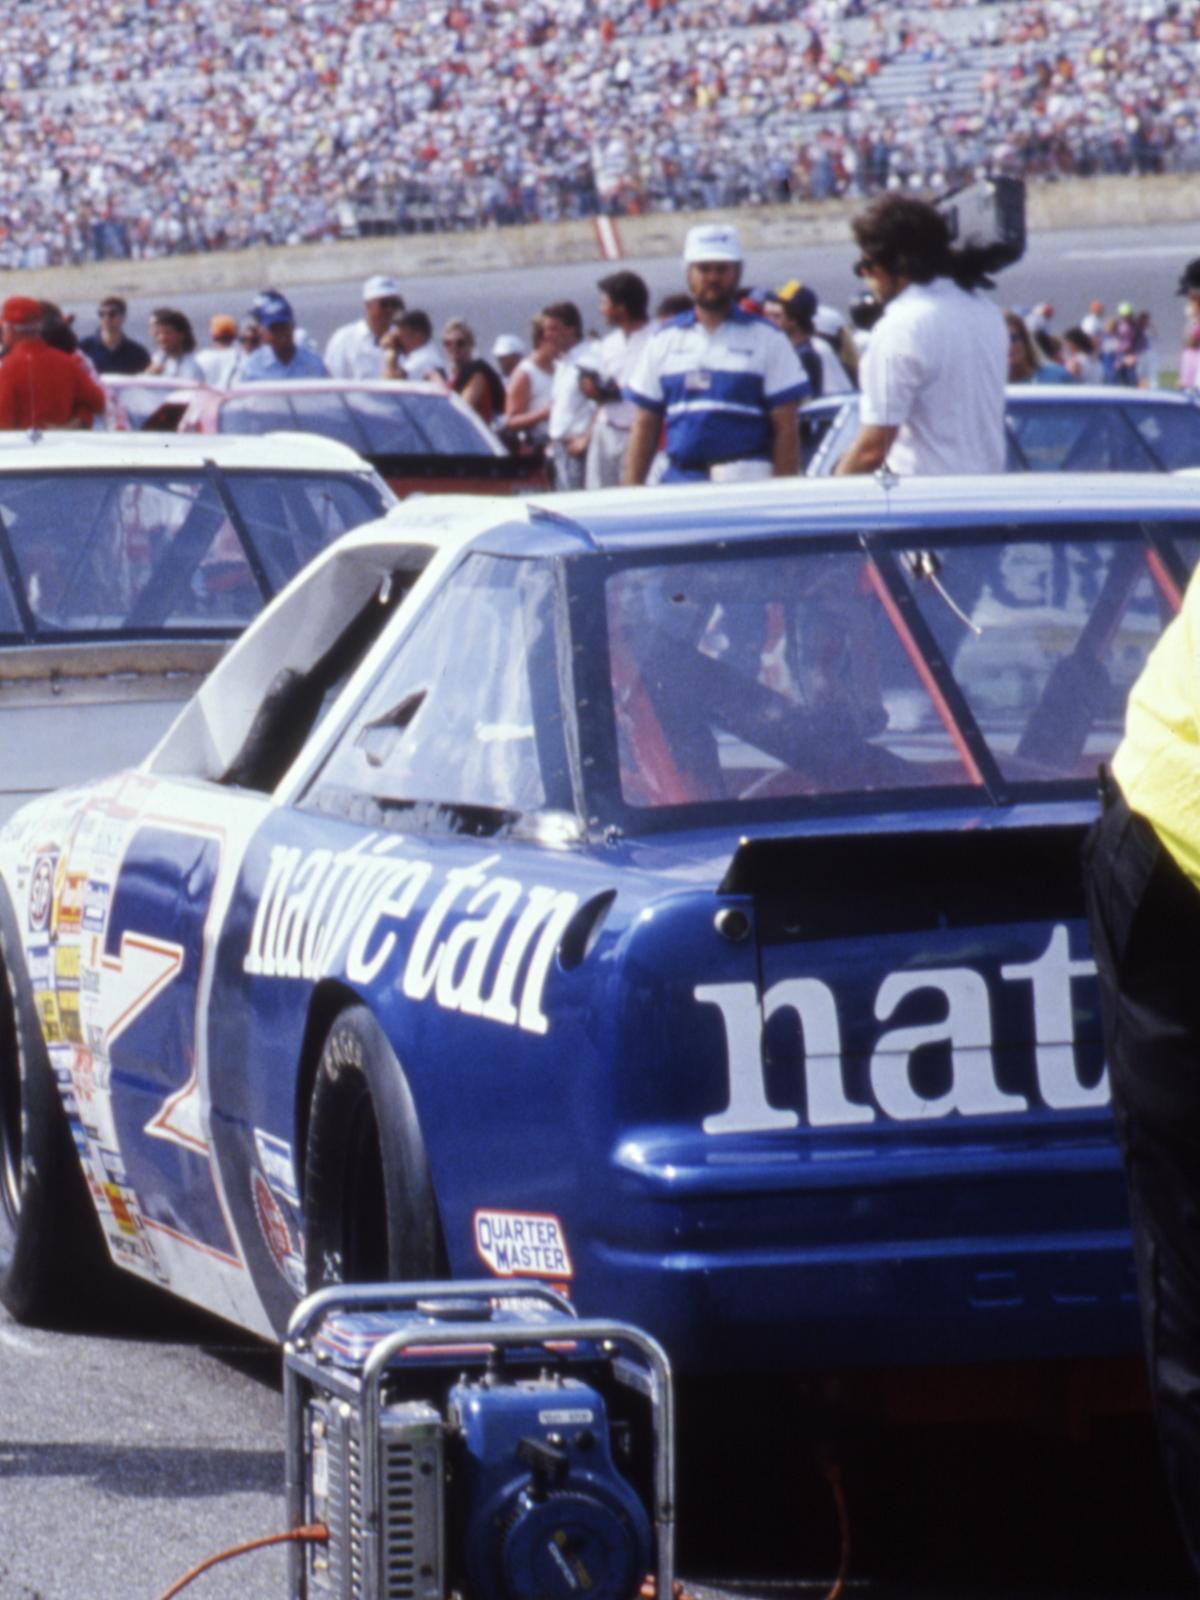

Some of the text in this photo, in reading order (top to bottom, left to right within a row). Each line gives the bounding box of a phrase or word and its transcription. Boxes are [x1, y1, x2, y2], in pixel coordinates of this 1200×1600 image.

[243, 831, 433, 984] native
[403, 854, 578, 1034] tan
[694, 924, 1112, 1134] nat
[479, 1217, 559, 1252] QUARTER
[495, 1242, 566, 1270] MASTER
